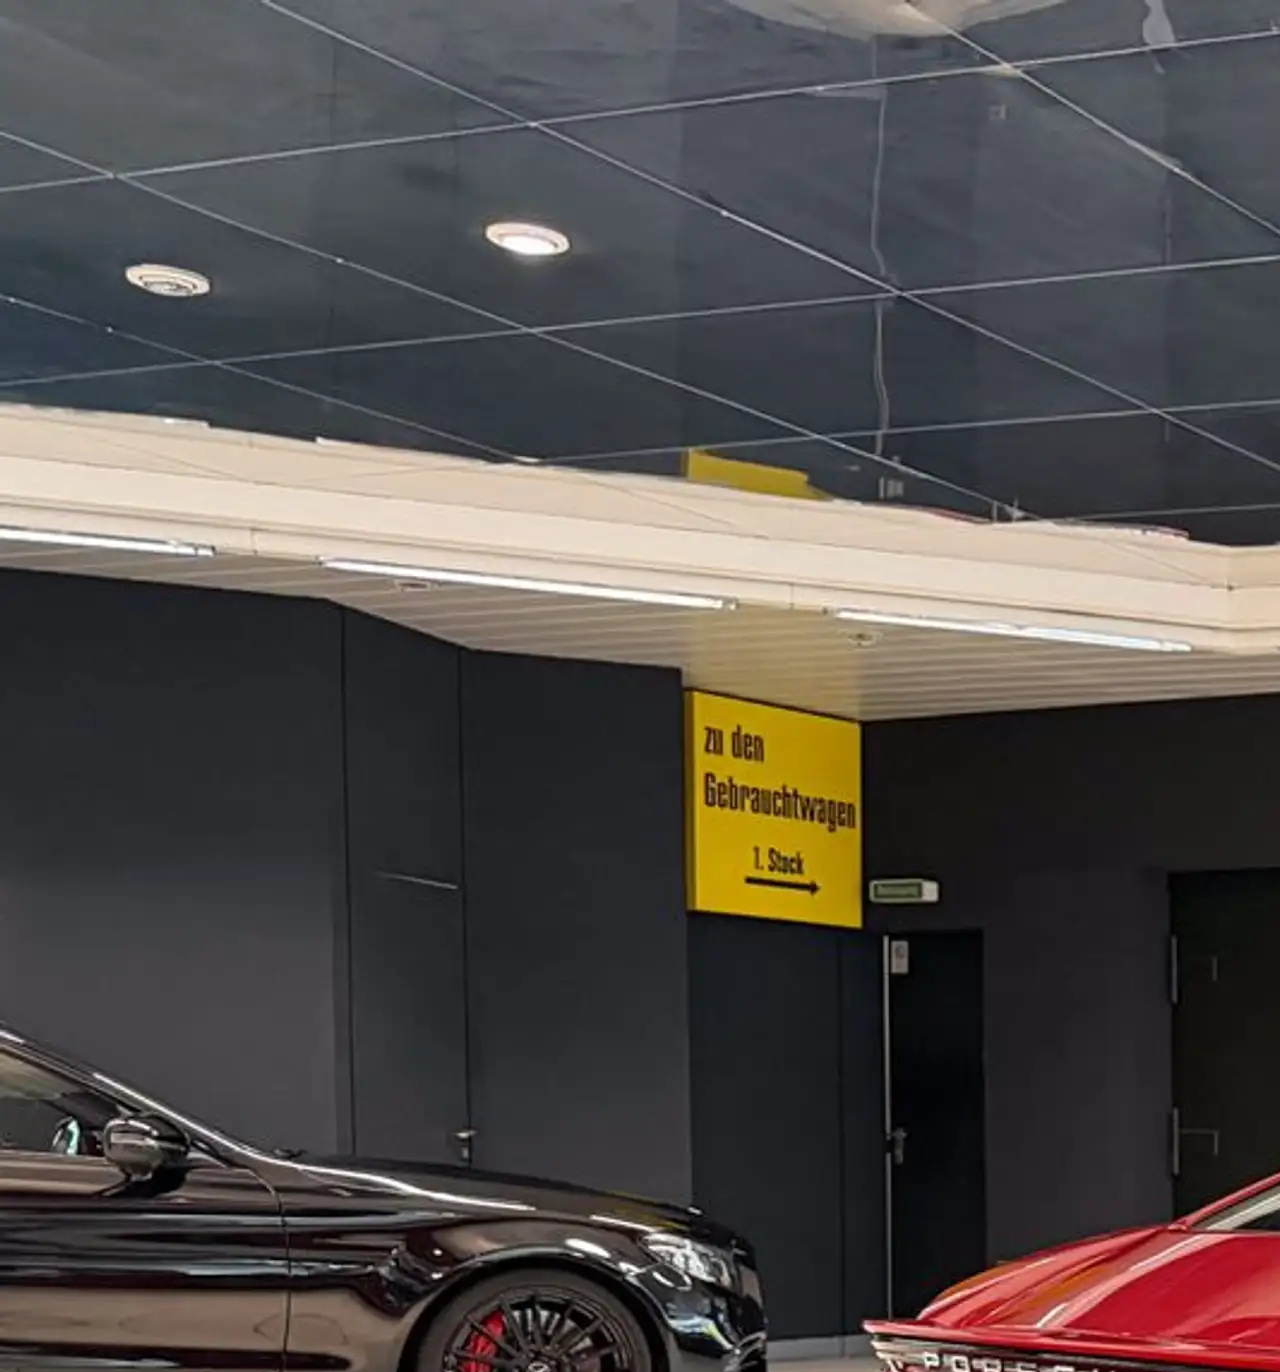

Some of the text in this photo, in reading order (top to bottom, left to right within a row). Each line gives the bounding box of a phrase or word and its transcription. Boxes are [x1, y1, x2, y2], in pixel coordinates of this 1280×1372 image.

[703, 724, 765, 762] zu den
[703, 772, 857, 833] Gebrauchtwagen
[753, 846, 805, 876] 1. Stock
